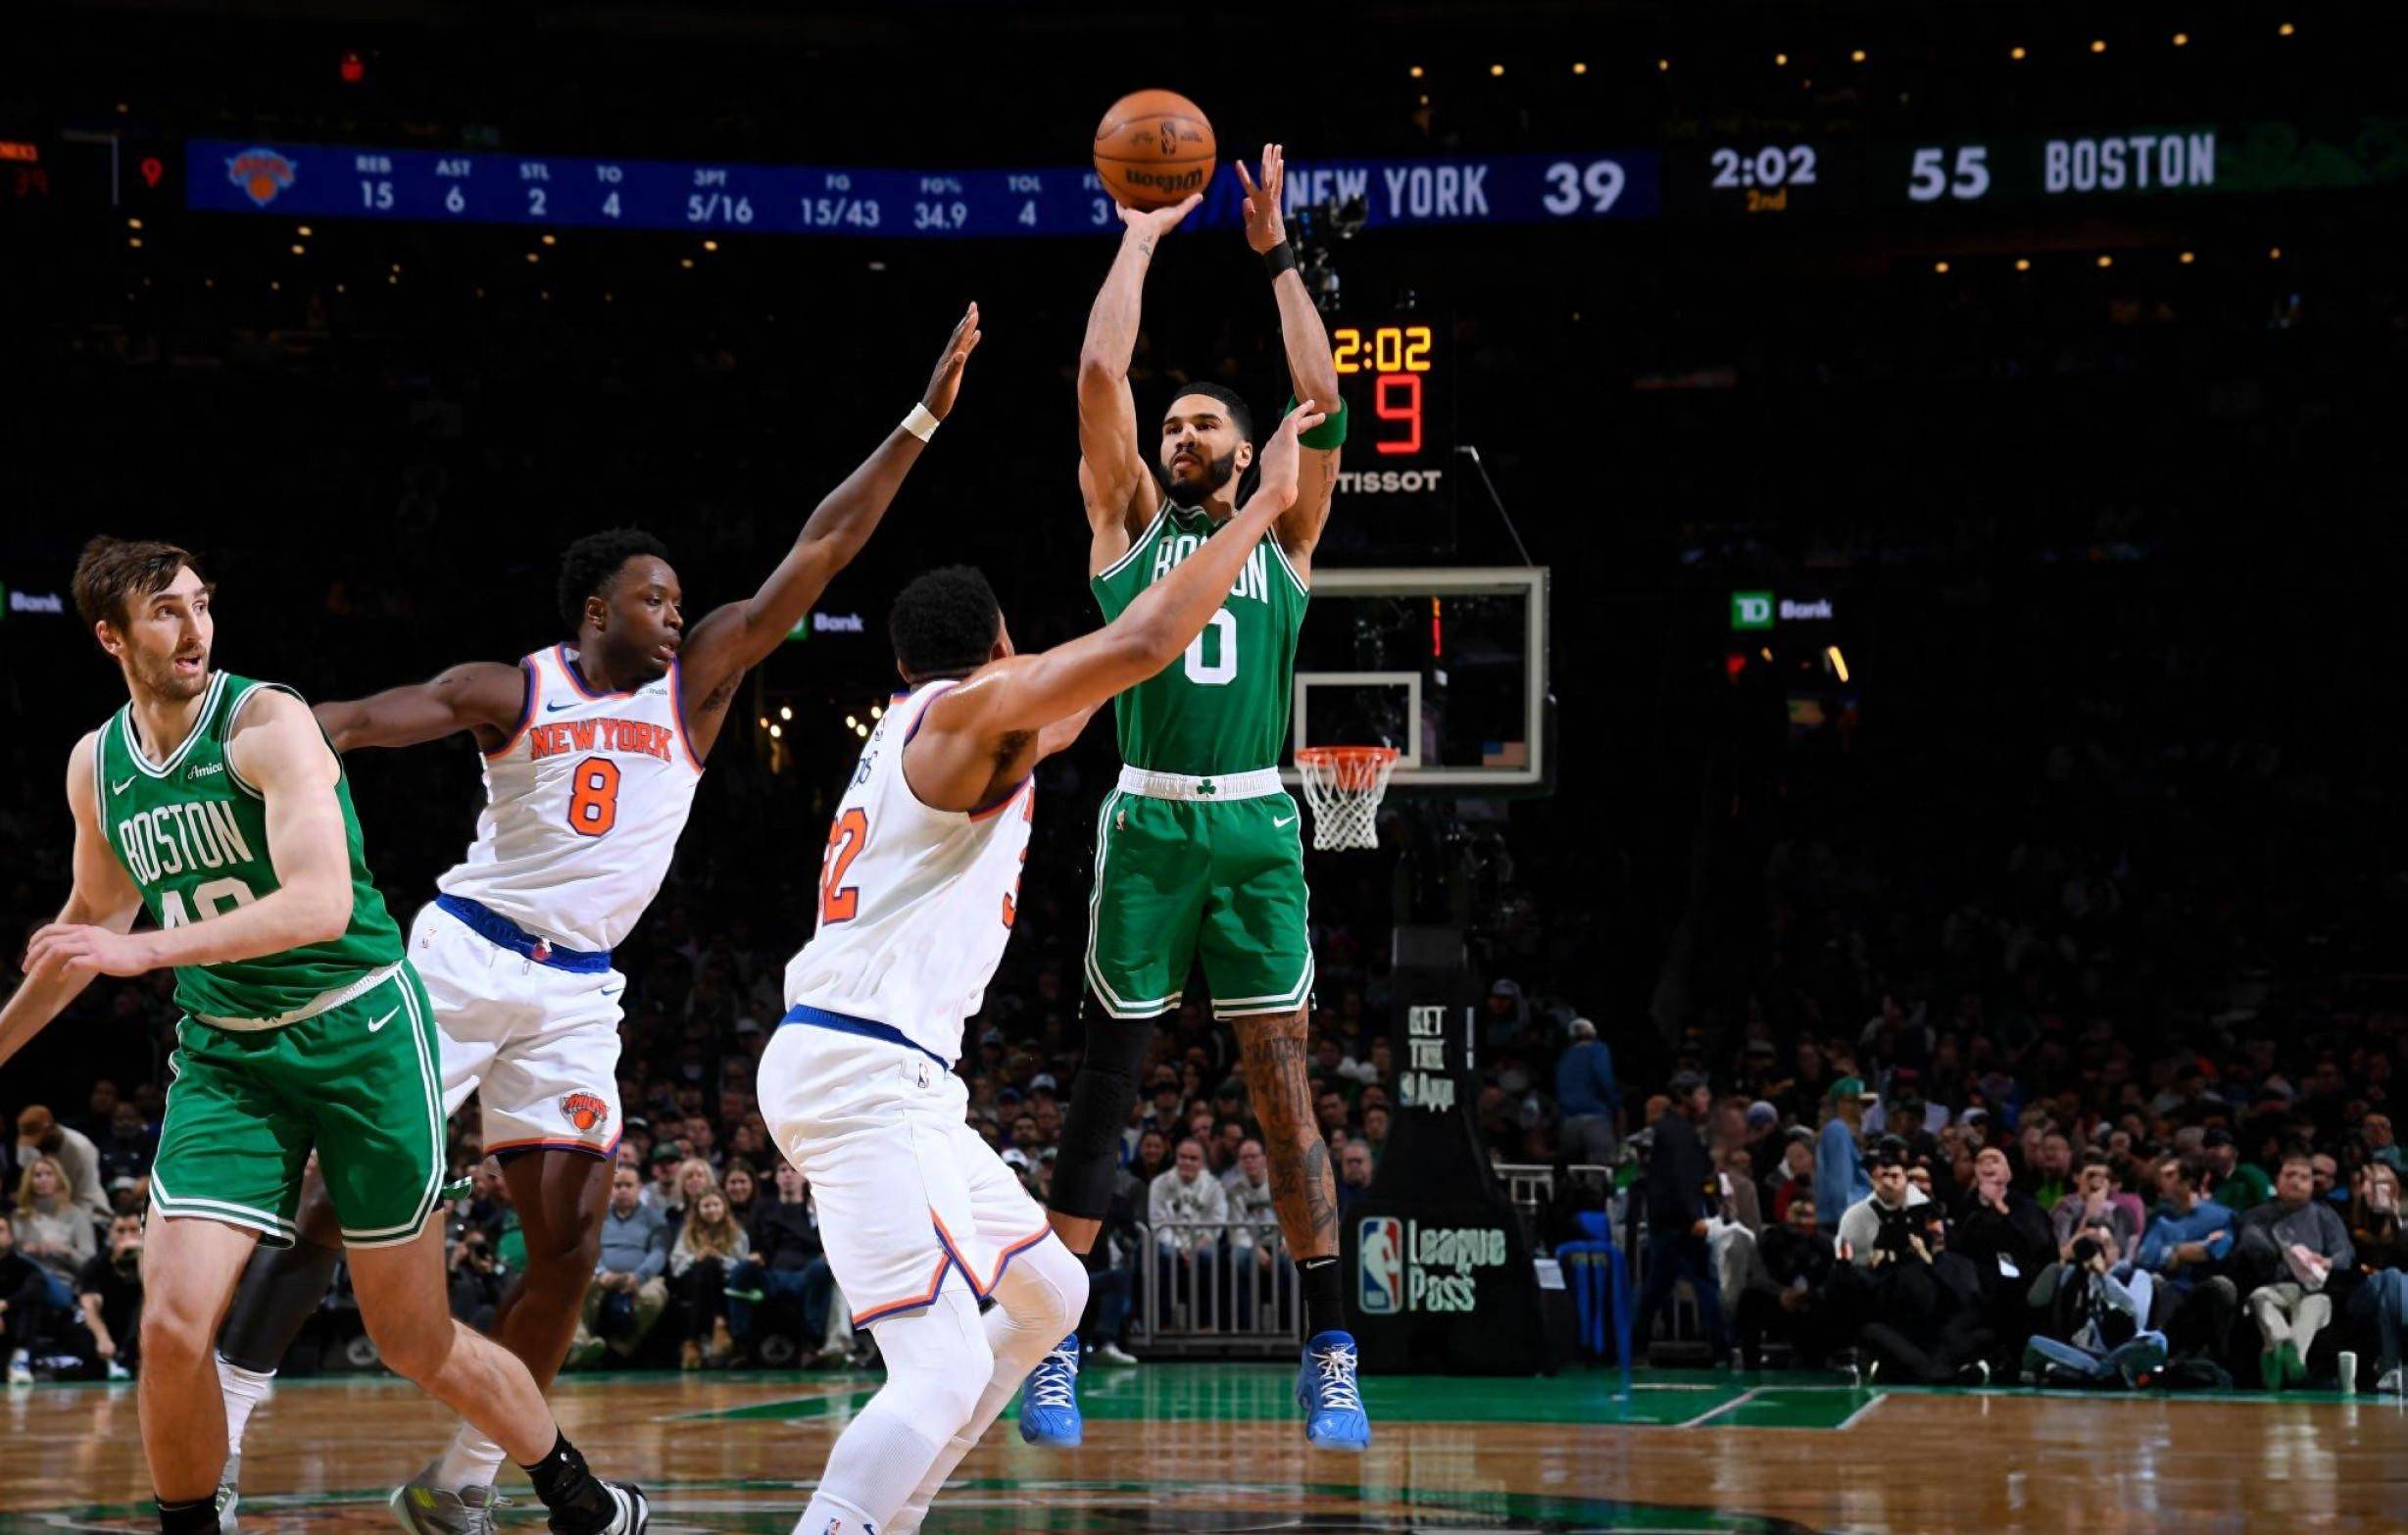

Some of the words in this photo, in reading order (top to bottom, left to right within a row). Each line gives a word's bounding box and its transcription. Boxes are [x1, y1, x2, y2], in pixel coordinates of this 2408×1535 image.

[140, 157, 163, 189] 9
[355, 155, 392, 173] REB
[435, 159, 471, 177] AST
[519, 162, 551, 181] STL
[596, 165, 623, 183] TO
[1711, 145, 1817, 187] 2:02
[1907, 146, 1990, 201] 55
[2044, 133, 2215, 193] BOSTON
[361, 179, 395, 210] 15
[445, 184, 466, 214] 6
[528, 187, 547, 216] 2
[1285, 169, 1369, 218] NEW
[1383, 165, 1489, 219] YORK
[1543, 160, 1626, 216] 39
[1745, 188, 1788, 213] 2nd
[602, 191, 621, 219] 4
[687, 193, 754, 223] 5/16
[801, 197, 881, 227] 15/43
[913, 201, 968, 230] 34.9
[1018, 200, 1037, 226] 4
[1091, 198, 1108, 225] 3
[1334, 326, 1432, 373] 2:02
[1376, 373, 1422, 455] 9
[1337, 470, 1443, 493] TISSOT
[813, 612, 863, 632] Bank
[1737, 597, 1770, 622] TD
[1779, 599, 1833, 619] Bank
[1184, 607, 1237, 684] 0
[187, 762, 223, 780] Amica
[567, 756, 621, 837] 8
[119, 800, 255, 886] BOSTON
[1407, 1218, 1506, 1274] League
[1407, 1265, 1476, 1312] Pass
